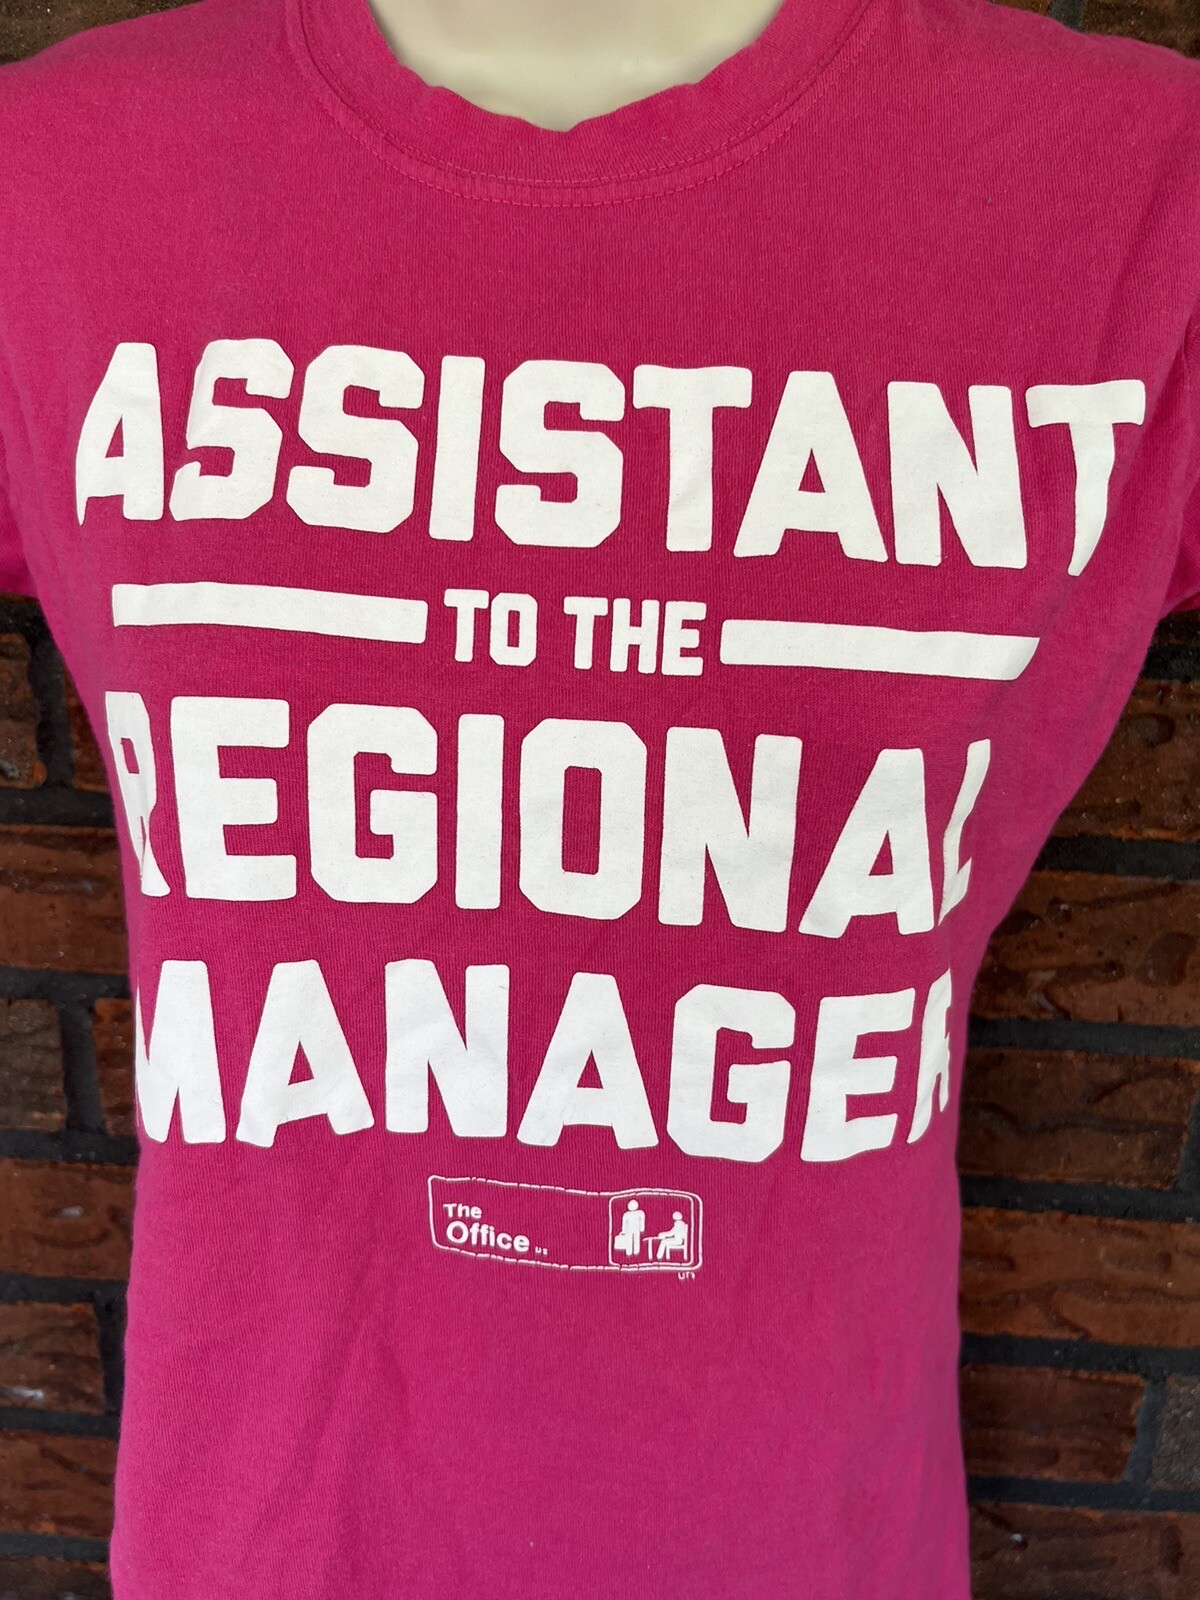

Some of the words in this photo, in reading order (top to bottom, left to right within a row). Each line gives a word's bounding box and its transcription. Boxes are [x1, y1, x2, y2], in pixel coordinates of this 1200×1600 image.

[76, 339, 1145, 576] ASSISTANT
[444, 589, 537, 666] TO
[564, 597, 706, 675] THE
[105, 691, 991, 938] REGIONAL
[135, 959, 951, 1162] MANAGER
[443, 1203, 482, 1219] The
[446, 1220, 530, 1252] Office
